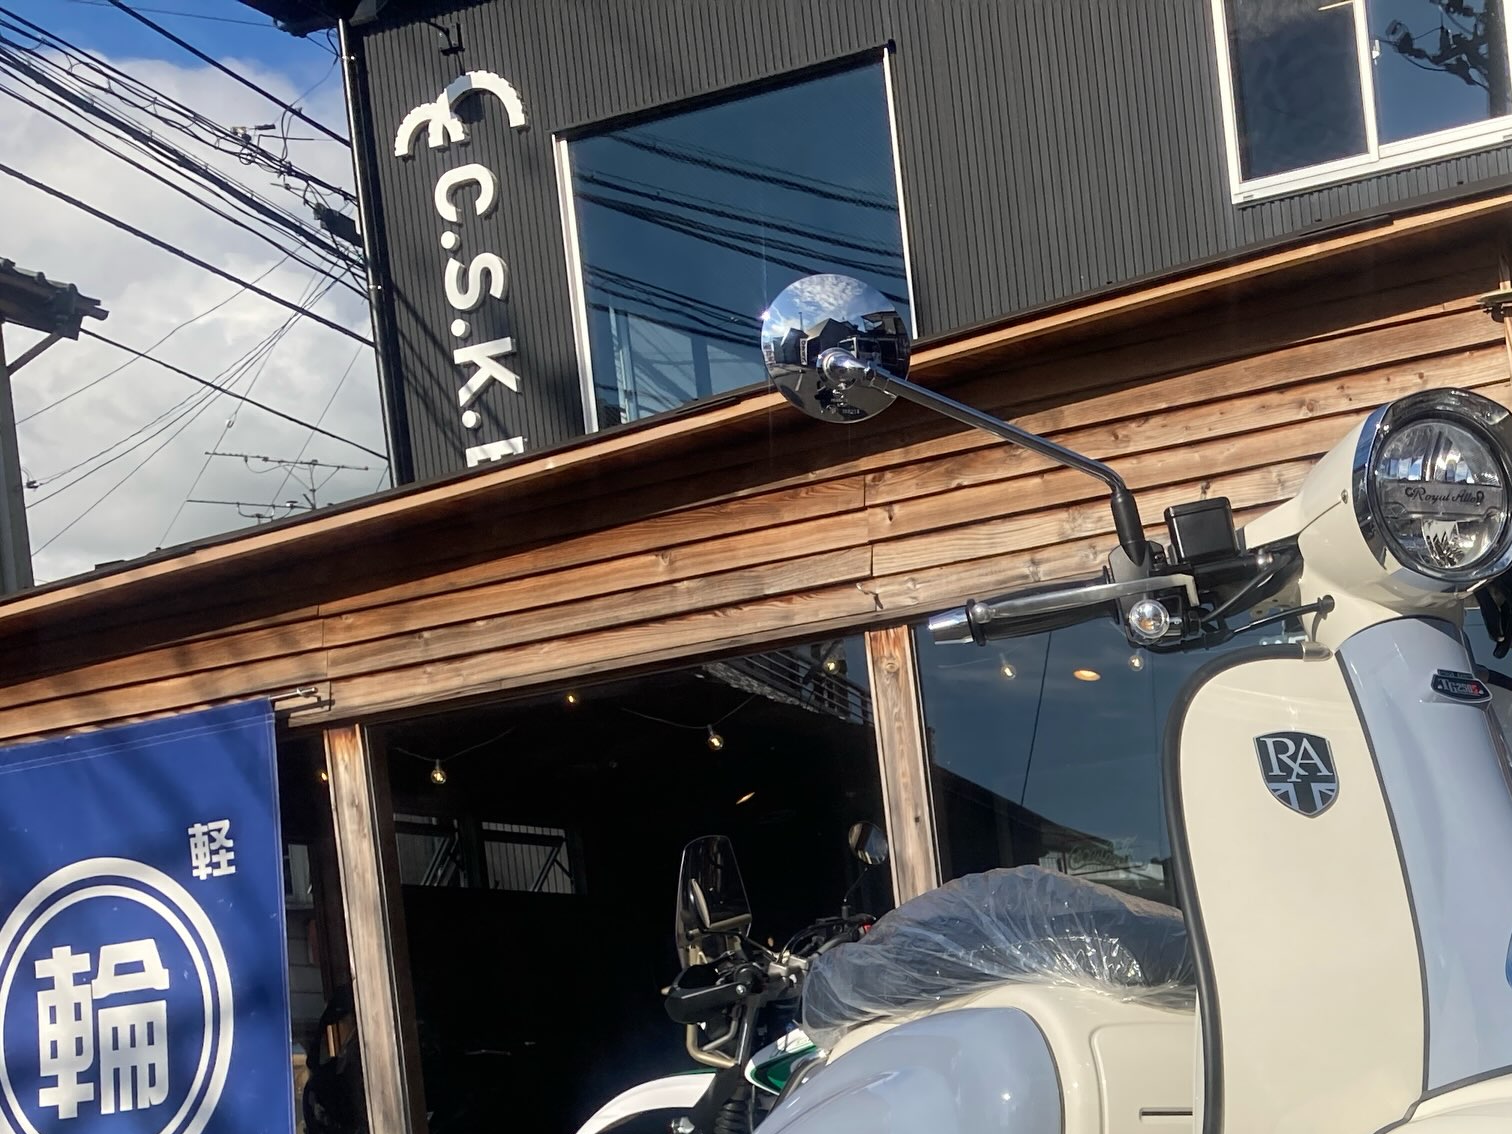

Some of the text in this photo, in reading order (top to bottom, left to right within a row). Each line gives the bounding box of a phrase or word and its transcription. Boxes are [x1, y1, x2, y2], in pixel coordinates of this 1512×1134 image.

[1259, 737, 1334, 782] RA
[187, 818, 236, 881] 軽
[34, 938, 170, 1120] 輪
